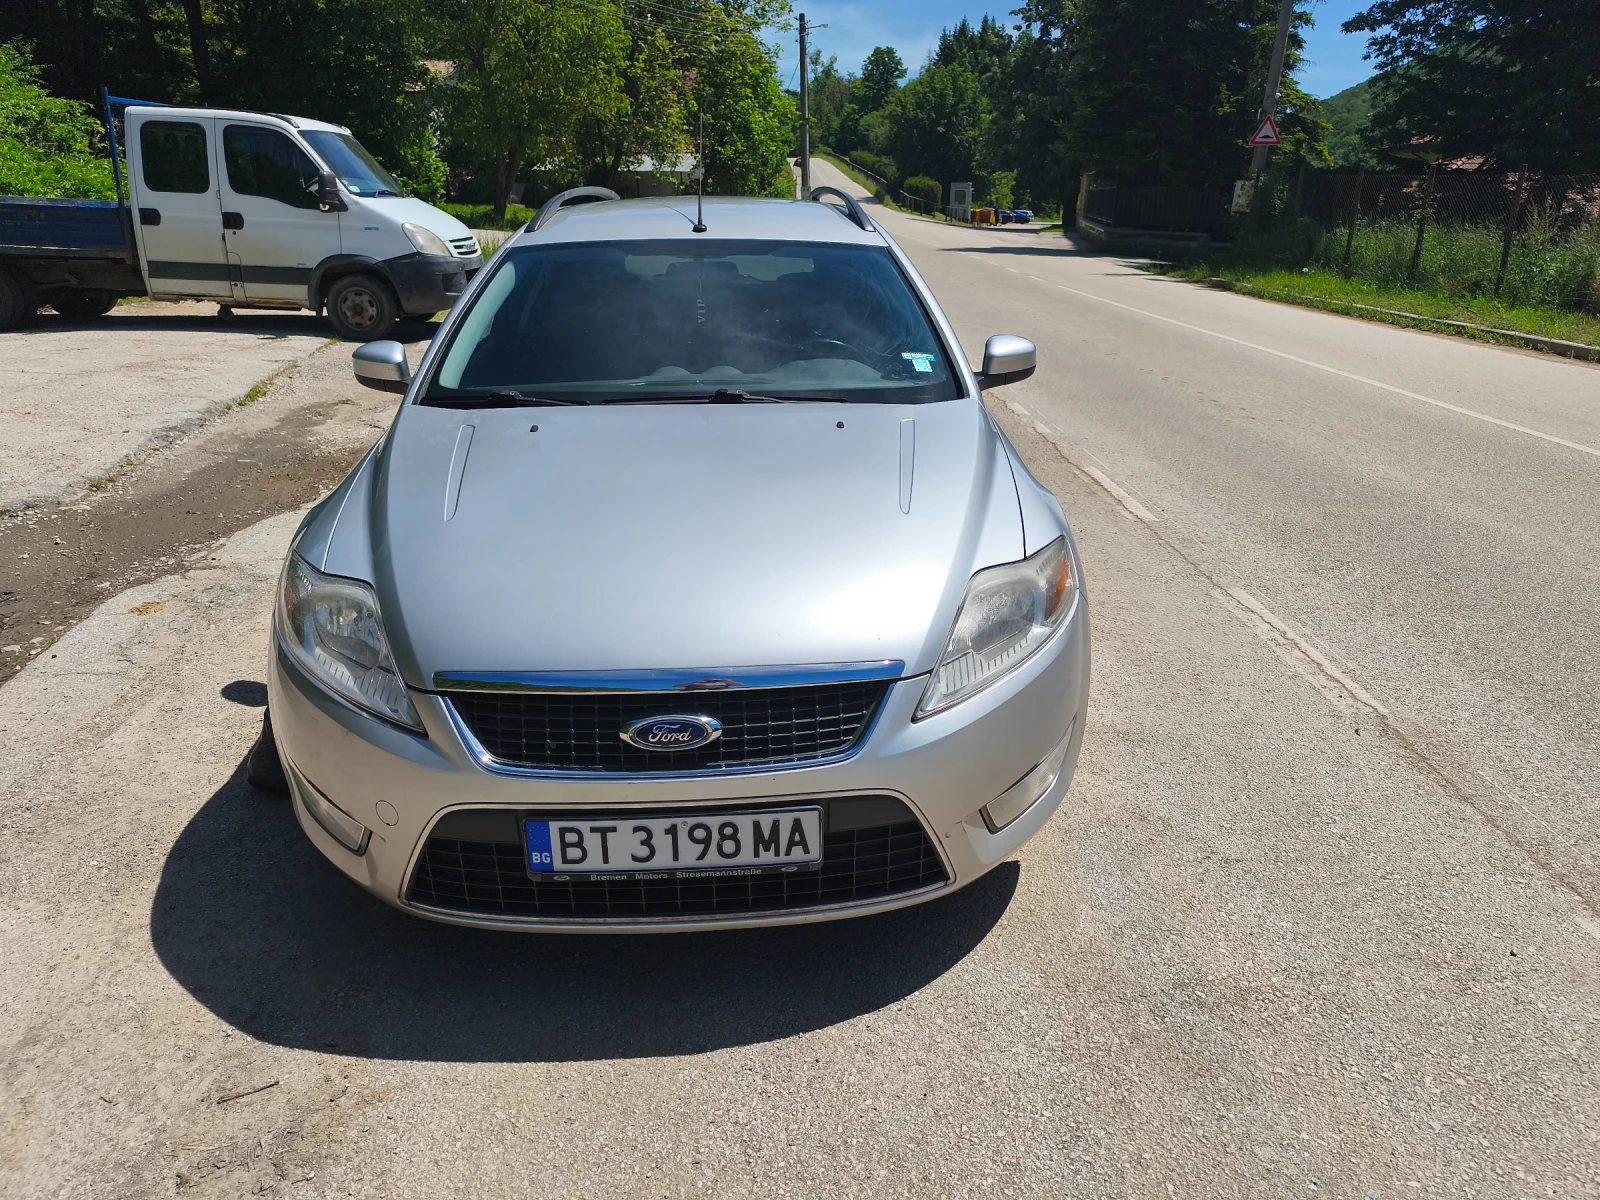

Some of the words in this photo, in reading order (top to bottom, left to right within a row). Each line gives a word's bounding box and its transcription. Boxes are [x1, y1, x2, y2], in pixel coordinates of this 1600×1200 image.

[697, 299, 706, 324] VIP
[648, 724, 692, 742] Ford
[558, 826, 618, 865] BT
[631, 821, 742, 864] 3198
[752, 818, 811, 858] MA
[532, 852, 551, 864] BG
[635, 872, 669, 880] Motors
[676, 868, 762, 879] Stresemannstraße
